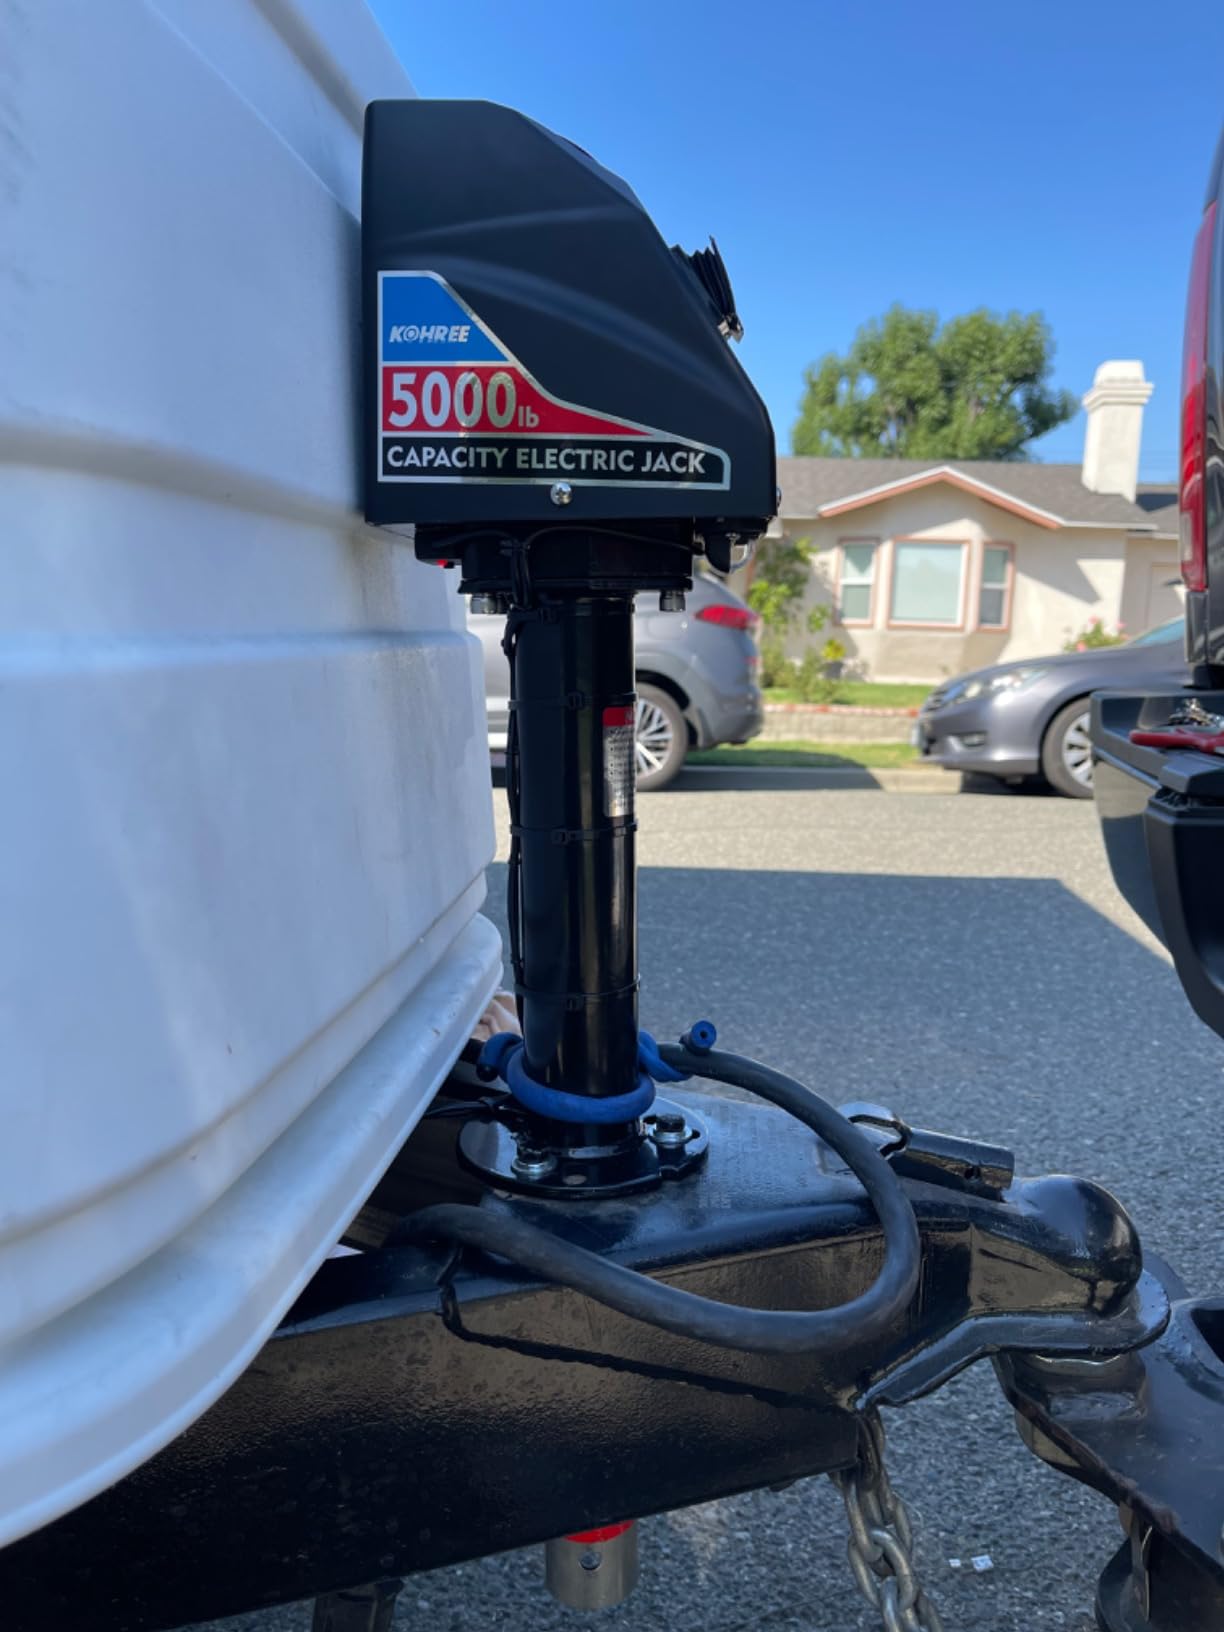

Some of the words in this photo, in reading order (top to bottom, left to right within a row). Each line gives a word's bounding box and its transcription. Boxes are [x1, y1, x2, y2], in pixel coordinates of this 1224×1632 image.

[389, 325, 471, 343] KOHREE
[387, 446, 509, 468] CAPACITY
[516, 447, 635, 472] ELECTRIC
[641, 451, 707, 474] JACK
